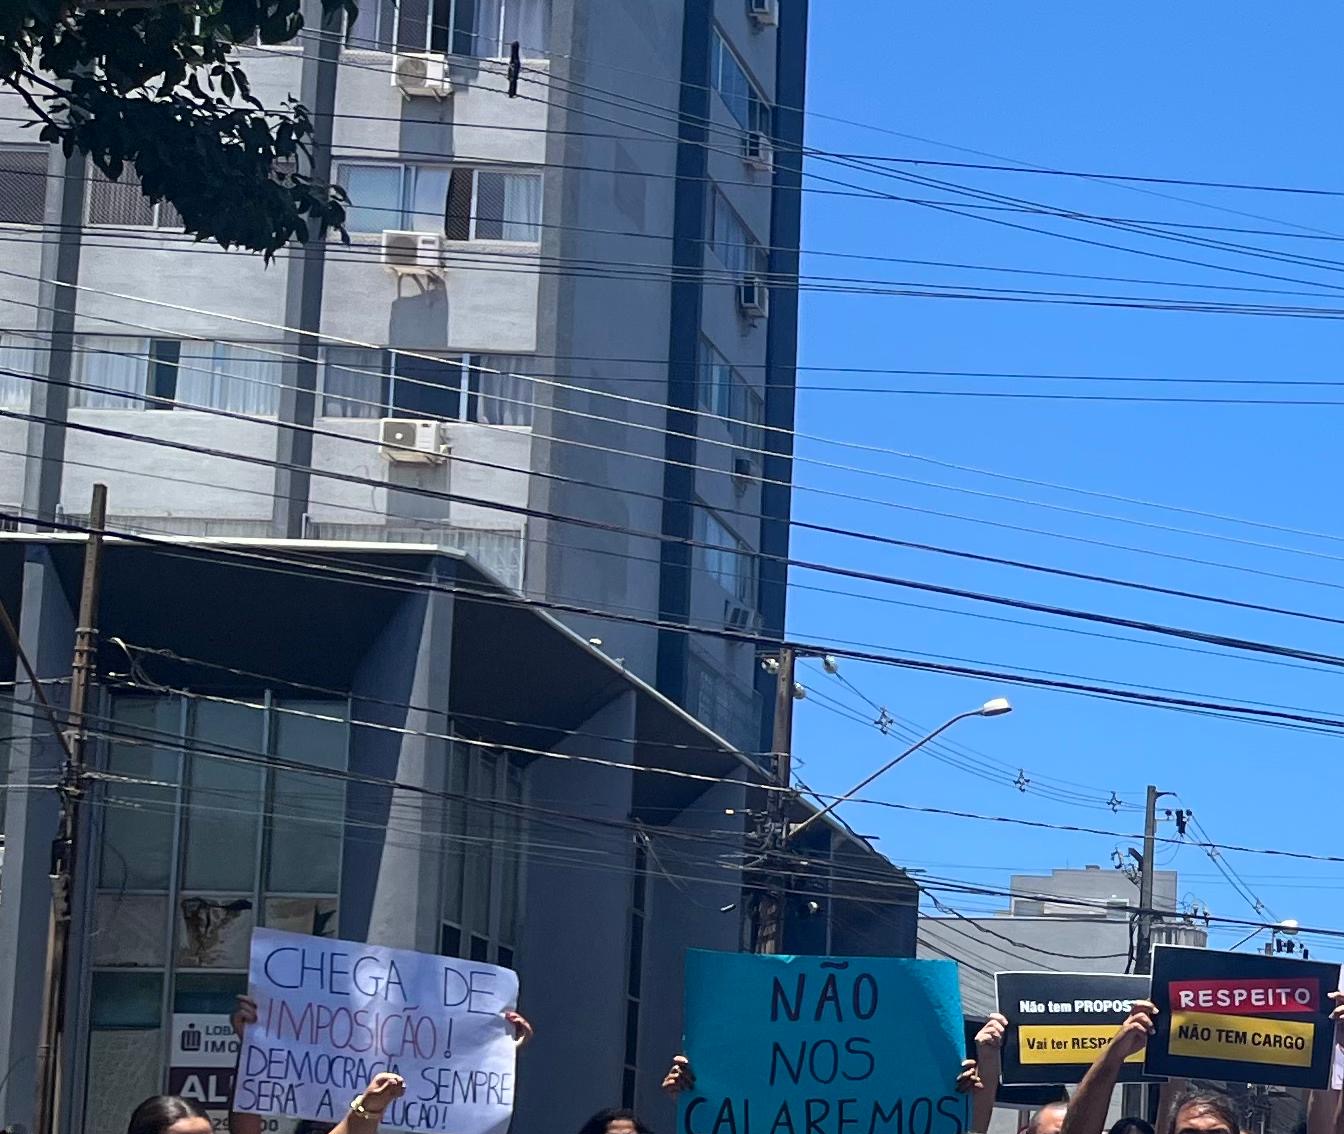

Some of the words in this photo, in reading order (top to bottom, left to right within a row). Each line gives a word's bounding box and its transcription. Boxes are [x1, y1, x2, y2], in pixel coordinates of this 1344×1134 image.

[264, 947, 408, 1002] CHEGA
[444, 966, 505, 1016] DE
[769, 960, 879, 1023] NÃO
[1178, 987, 1311, 1008] RESPEITO
[1019, 1000, 1046, 1013] Não
[1048, 1001, 1072, 1013] tem
[1074, 1000, 1134, 1013] PROPOS
[265, 998, 453, 1063] IMPOSIÇÃO!
[1026, 1037, 1047, 1050] Vai
[1051, 1038, 1069, 1050] ter
[1178, 1023, 1211, 1042] NÃO
[1216, 1028, 1247, 1045] TEM
[1251, 1032, 1305, 1051] CARGO
[769, 1037, 875, 1086] NOS
[238, 1079, 305, 1114] SERÁ
[316, 1088, 335, 1118] A
[417, 1066, 513, 1106] SEMPRE
